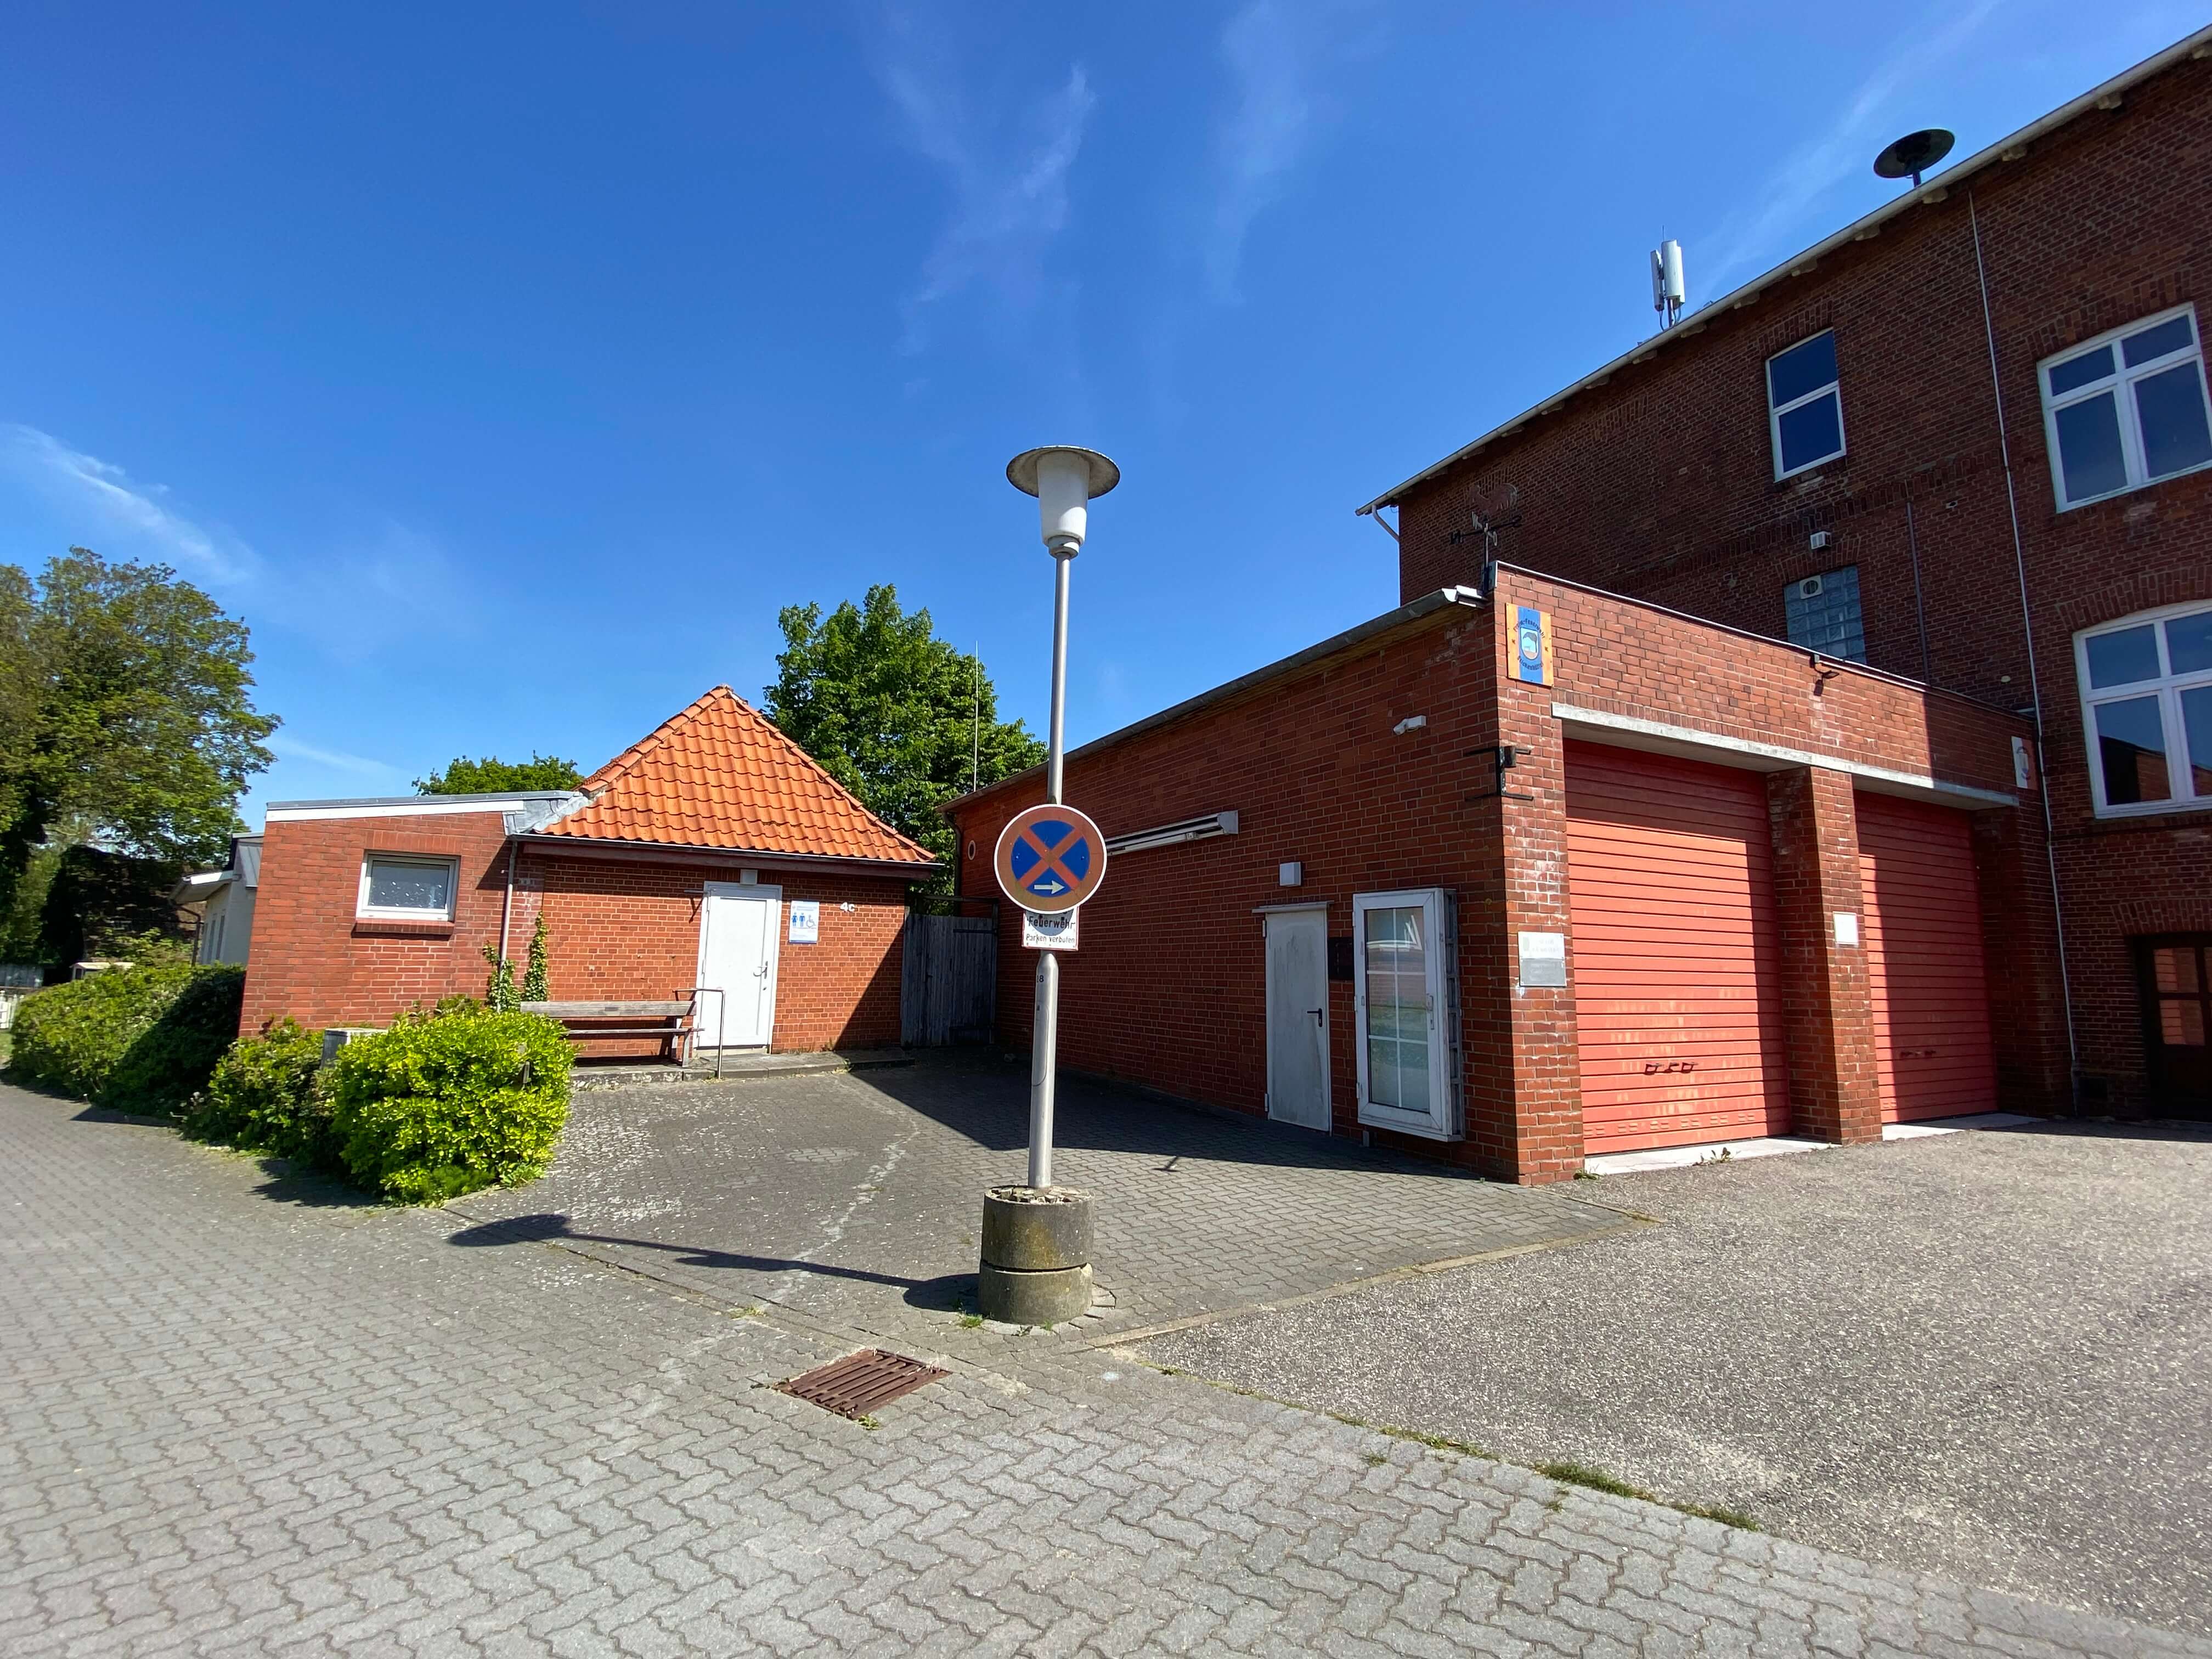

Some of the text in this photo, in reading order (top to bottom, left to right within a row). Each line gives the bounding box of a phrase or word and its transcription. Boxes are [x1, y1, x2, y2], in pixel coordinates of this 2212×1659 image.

[839, 902, 855, 912] 4c
[1029, 916, 1075, 929] Feuerwehr
[1026, 934, 1046, 943] Parken
